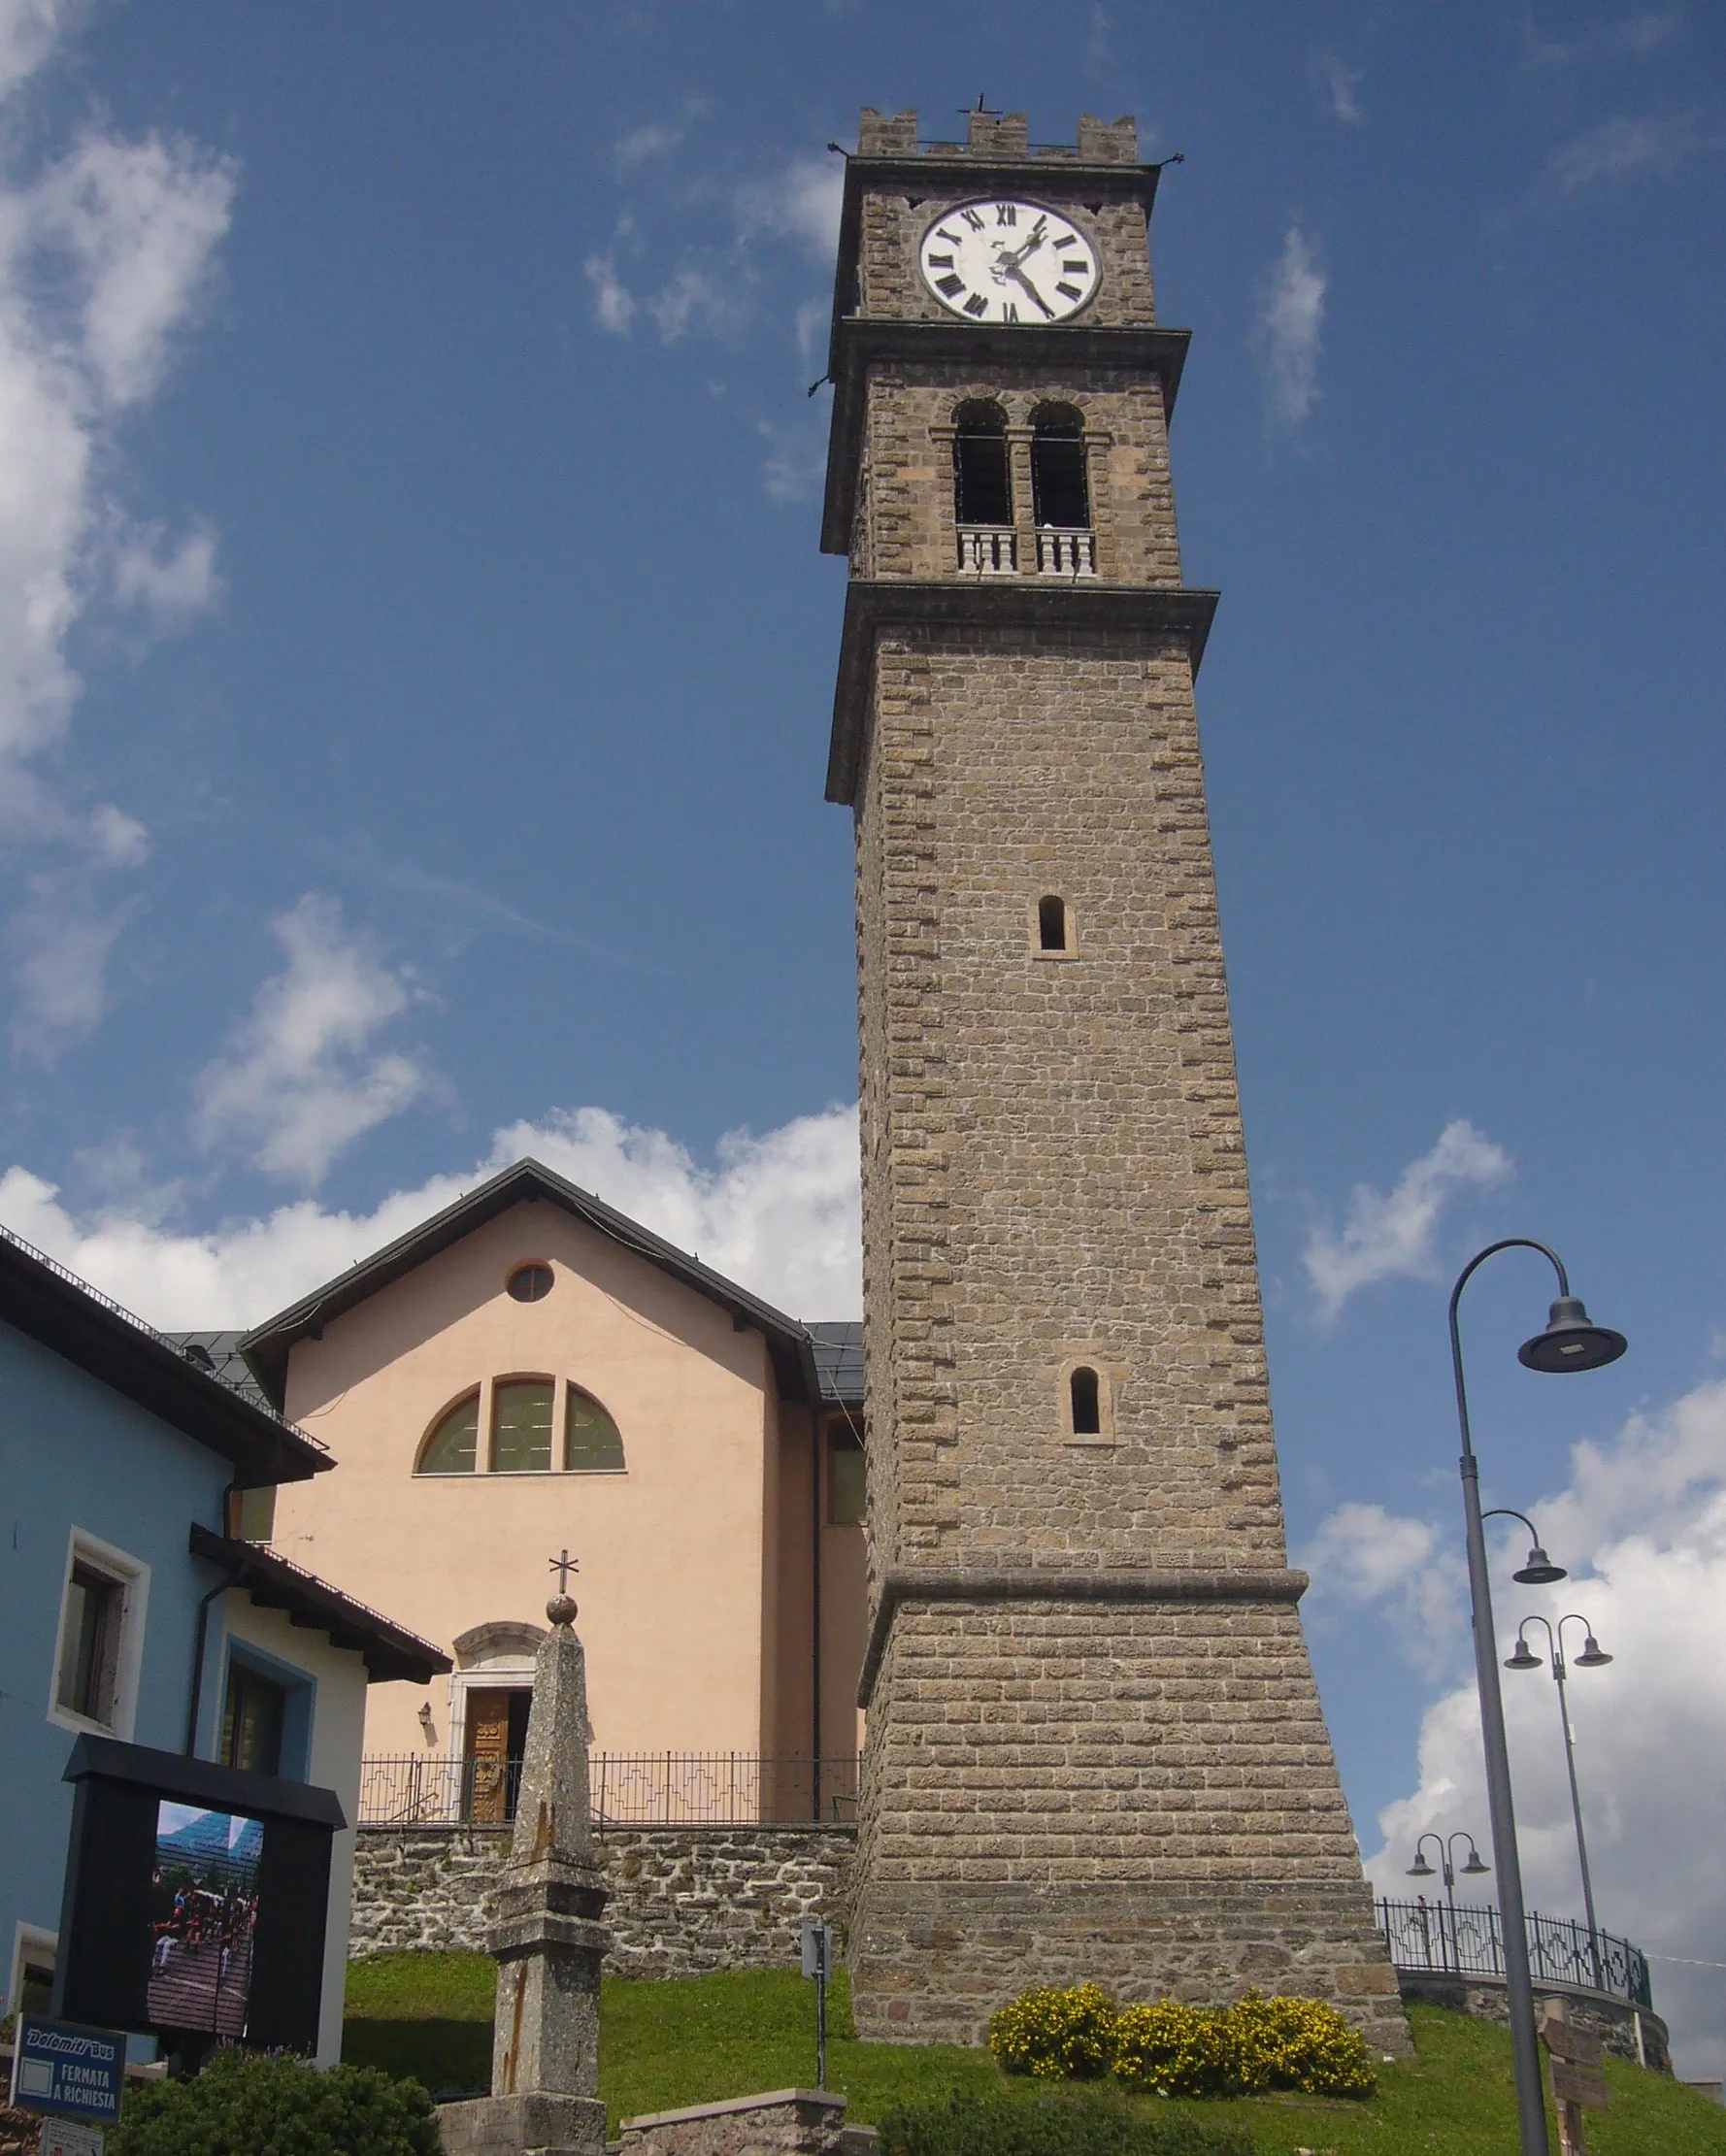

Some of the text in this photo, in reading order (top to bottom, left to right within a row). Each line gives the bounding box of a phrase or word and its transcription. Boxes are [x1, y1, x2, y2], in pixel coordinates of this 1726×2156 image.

[960, 209, 985, 232] XI
[996, 204, 1016, 226] XII
[936, 227, 962, 247] X
[1052, 234, 1078, 249] II
[928, 252, 953, 270] IX
[1062, 260, 1088, 274] III
[934, 273, 967, 300] VIII
[962, 291, 988, 318] VII
[1002, 302, 1019, 323] VI
[26, 2027, 90, 2056] Dolomiti
[61, 2063, 109, 2088] FERMATA
[53, 2084, 116, 2110] A RICHIESTA
